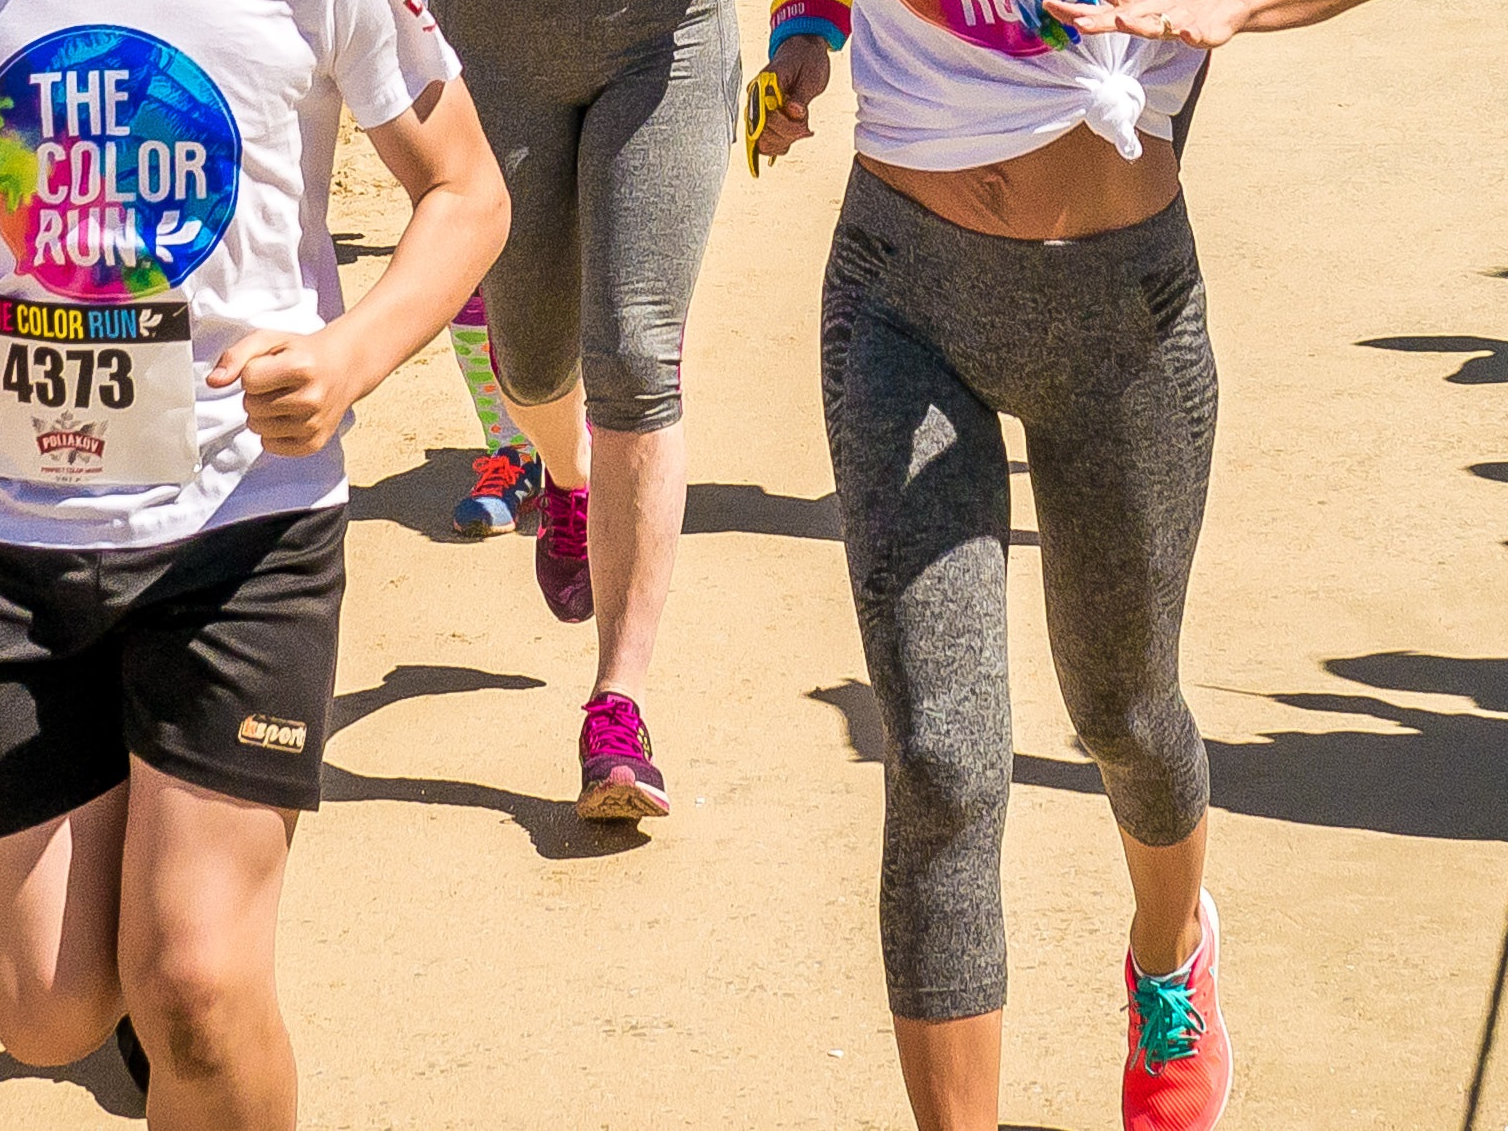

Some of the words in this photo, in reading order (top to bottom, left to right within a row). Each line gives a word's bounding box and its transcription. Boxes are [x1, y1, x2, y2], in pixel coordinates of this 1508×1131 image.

[29, 68, 131, 139] THE
[35, 139, 208, 205] COLOR
[33, 207, 138, 268] RUN
[16, 304, 85, 340] COLOR
[88, 308, 138, 340] RUN
[2, 341, 136, 410] 4373
